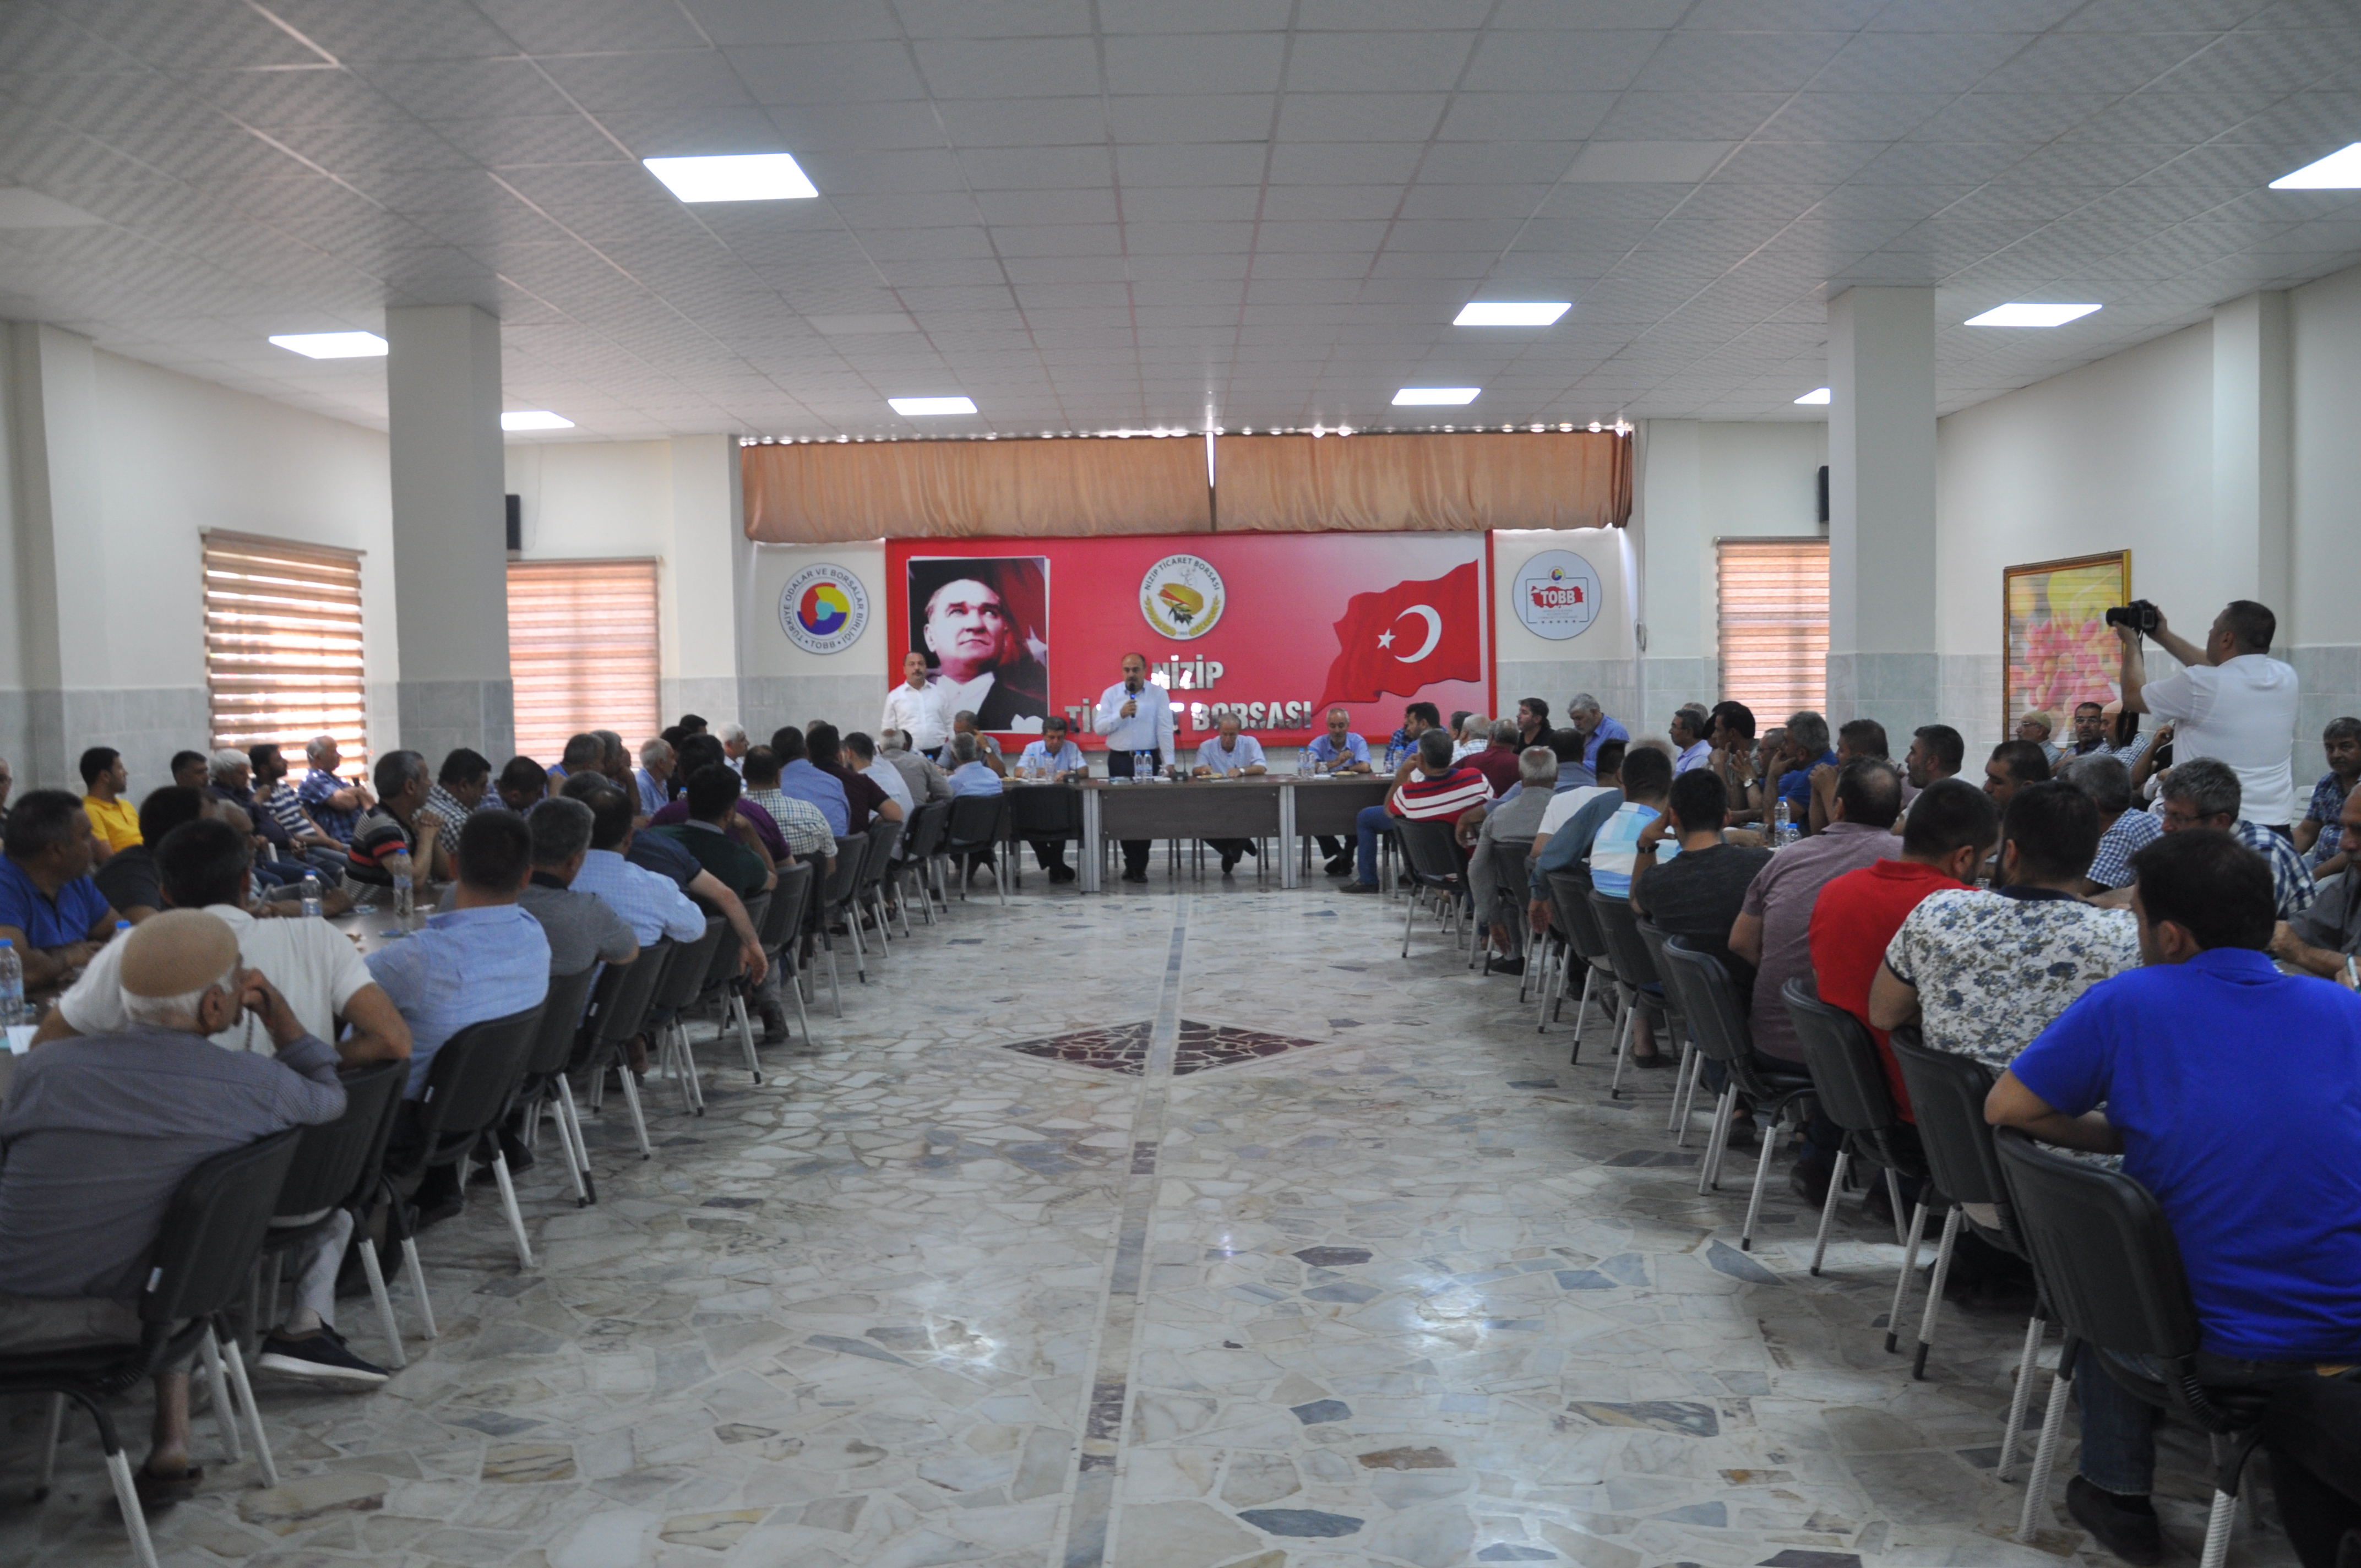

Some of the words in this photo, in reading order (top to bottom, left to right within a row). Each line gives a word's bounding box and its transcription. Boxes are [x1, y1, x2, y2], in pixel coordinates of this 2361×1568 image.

[785, 570, 813, 601] ODALAR
[830, 570, 863, 610] BORSALAR
[1145, 569, 1158, 591] NİZİP
[1158, 557, 1193, 571] TİCARET
[1194, 560, 1220, 590] BORSASI
[1540, 590, 1575, 605] TOBB
[810, 640, 836, 649] TOBB
[1151, 654, 1223, 689] NİZİP
